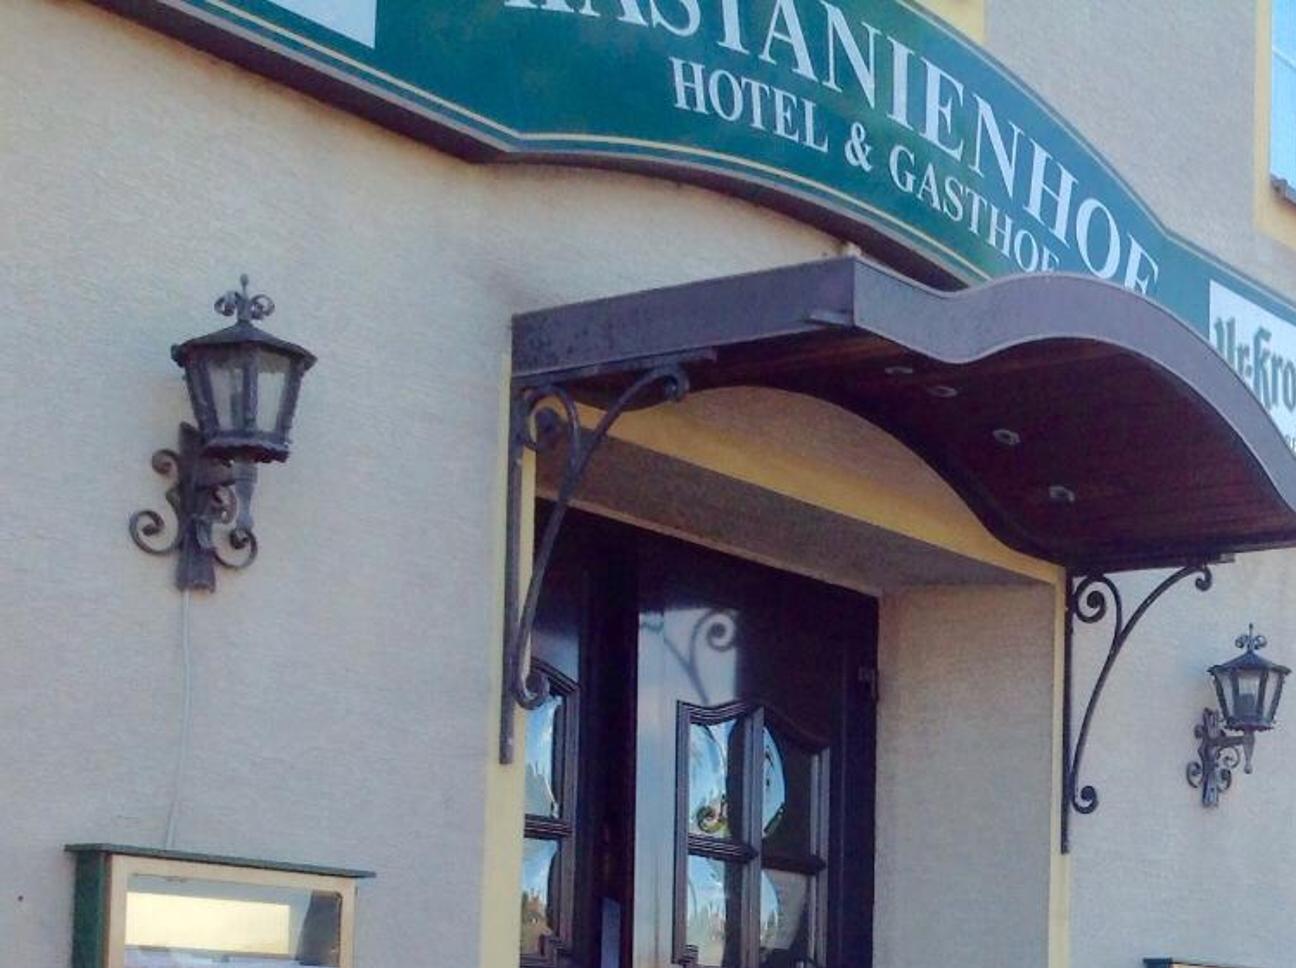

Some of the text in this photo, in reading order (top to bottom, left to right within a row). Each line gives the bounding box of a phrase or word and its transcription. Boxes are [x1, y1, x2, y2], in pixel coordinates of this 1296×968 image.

[669, 56, 1061, 272] HOTEL & GASTHOF
